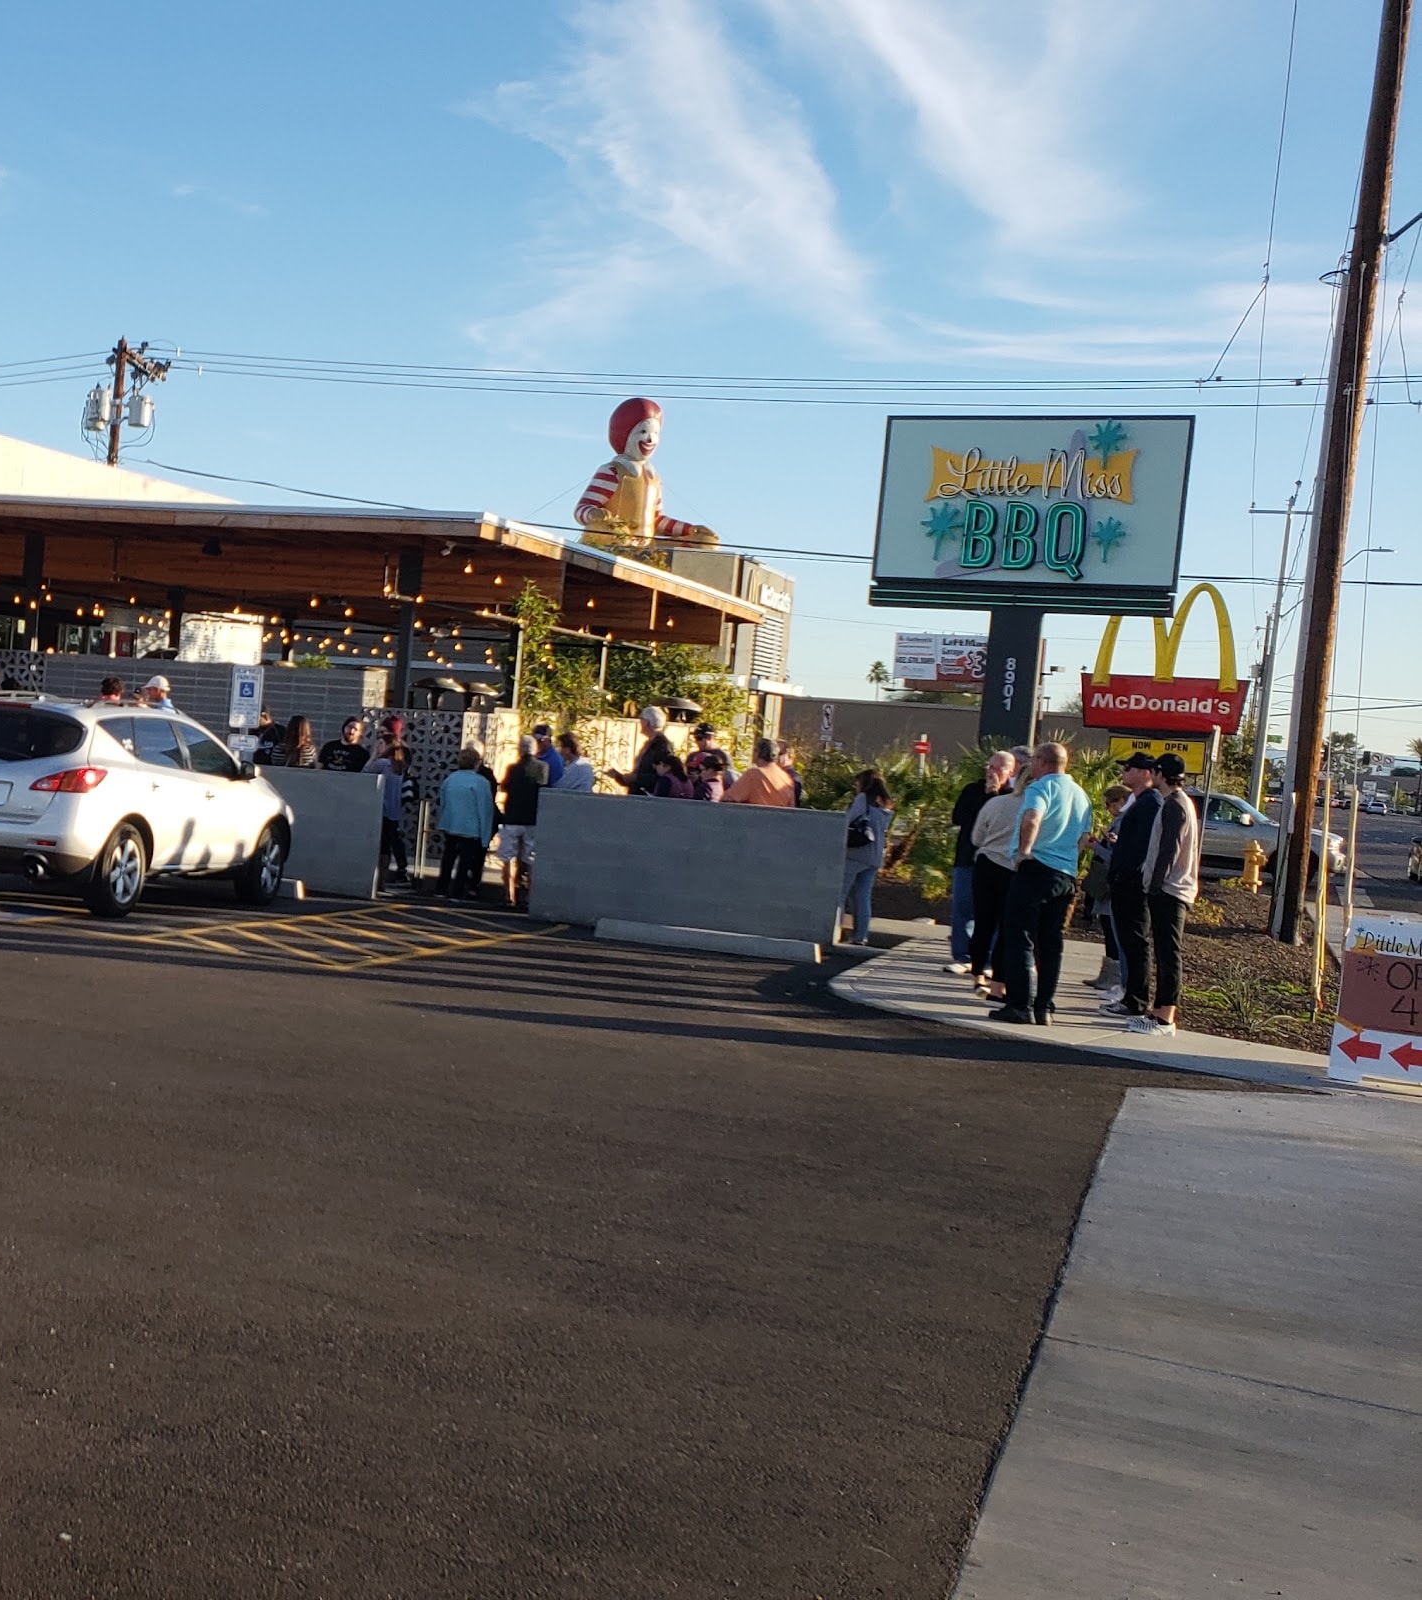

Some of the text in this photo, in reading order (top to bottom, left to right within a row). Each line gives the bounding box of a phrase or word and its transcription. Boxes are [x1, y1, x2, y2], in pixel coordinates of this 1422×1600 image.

[937, 447, 1122, 499] Little Miss
[960, 500, 1086, 580] BBQ
[1002, 657, 1017, 711] 8901
[1091, 692, 1231, 714] McDonald's
[1132, 741, 1189, 752] NOW OPEN
[1359, 931, 1403, 953] Little
